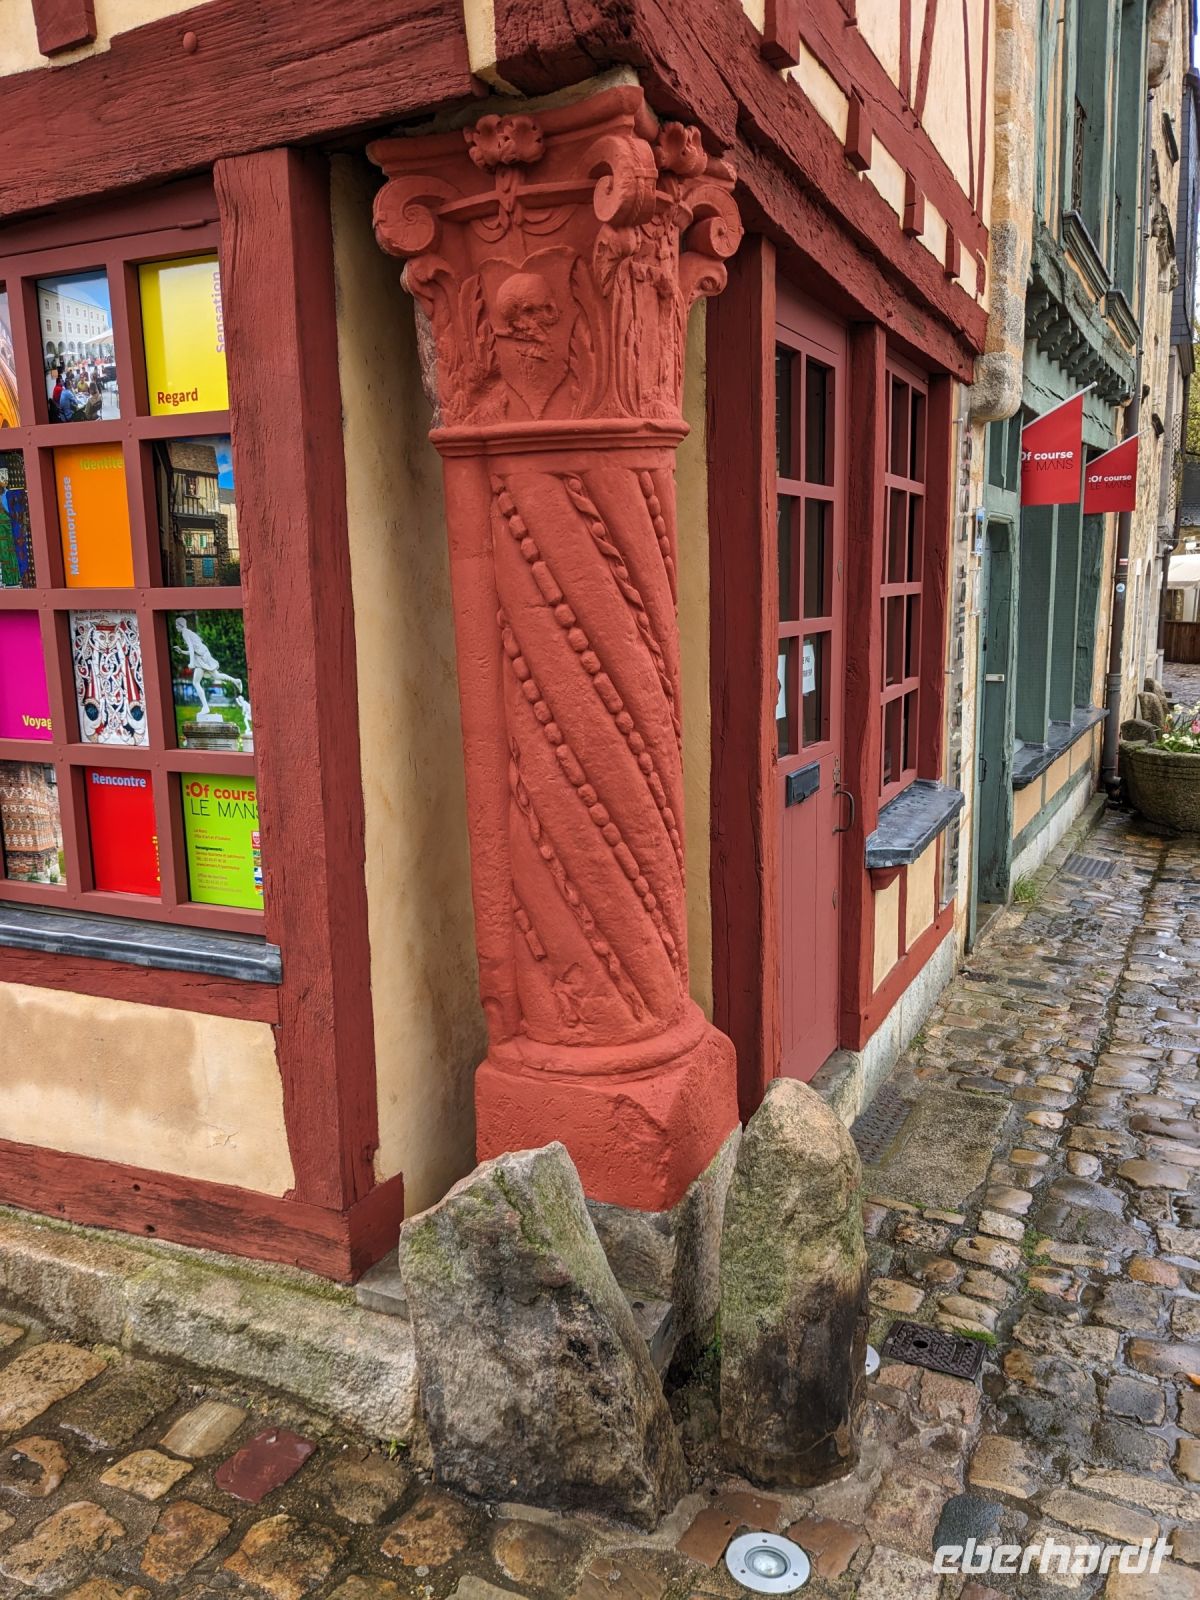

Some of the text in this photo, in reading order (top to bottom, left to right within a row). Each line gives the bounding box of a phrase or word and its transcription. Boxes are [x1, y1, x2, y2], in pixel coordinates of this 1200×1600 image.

[211, 271, 225, 353] Sensation
[157, 388, 199, 406] Regard
[1034, 450, 1074, 460] course
[1036, 459, 1073, 473] MANS
[1104, 474, 1132, 482] course
[1105, 481, 1132, 489] MANS
[64, 476, 80, 575] Métamorphose
[92, 773, 147, 788] Rencontre
[190, 798, 210, 816] LE
